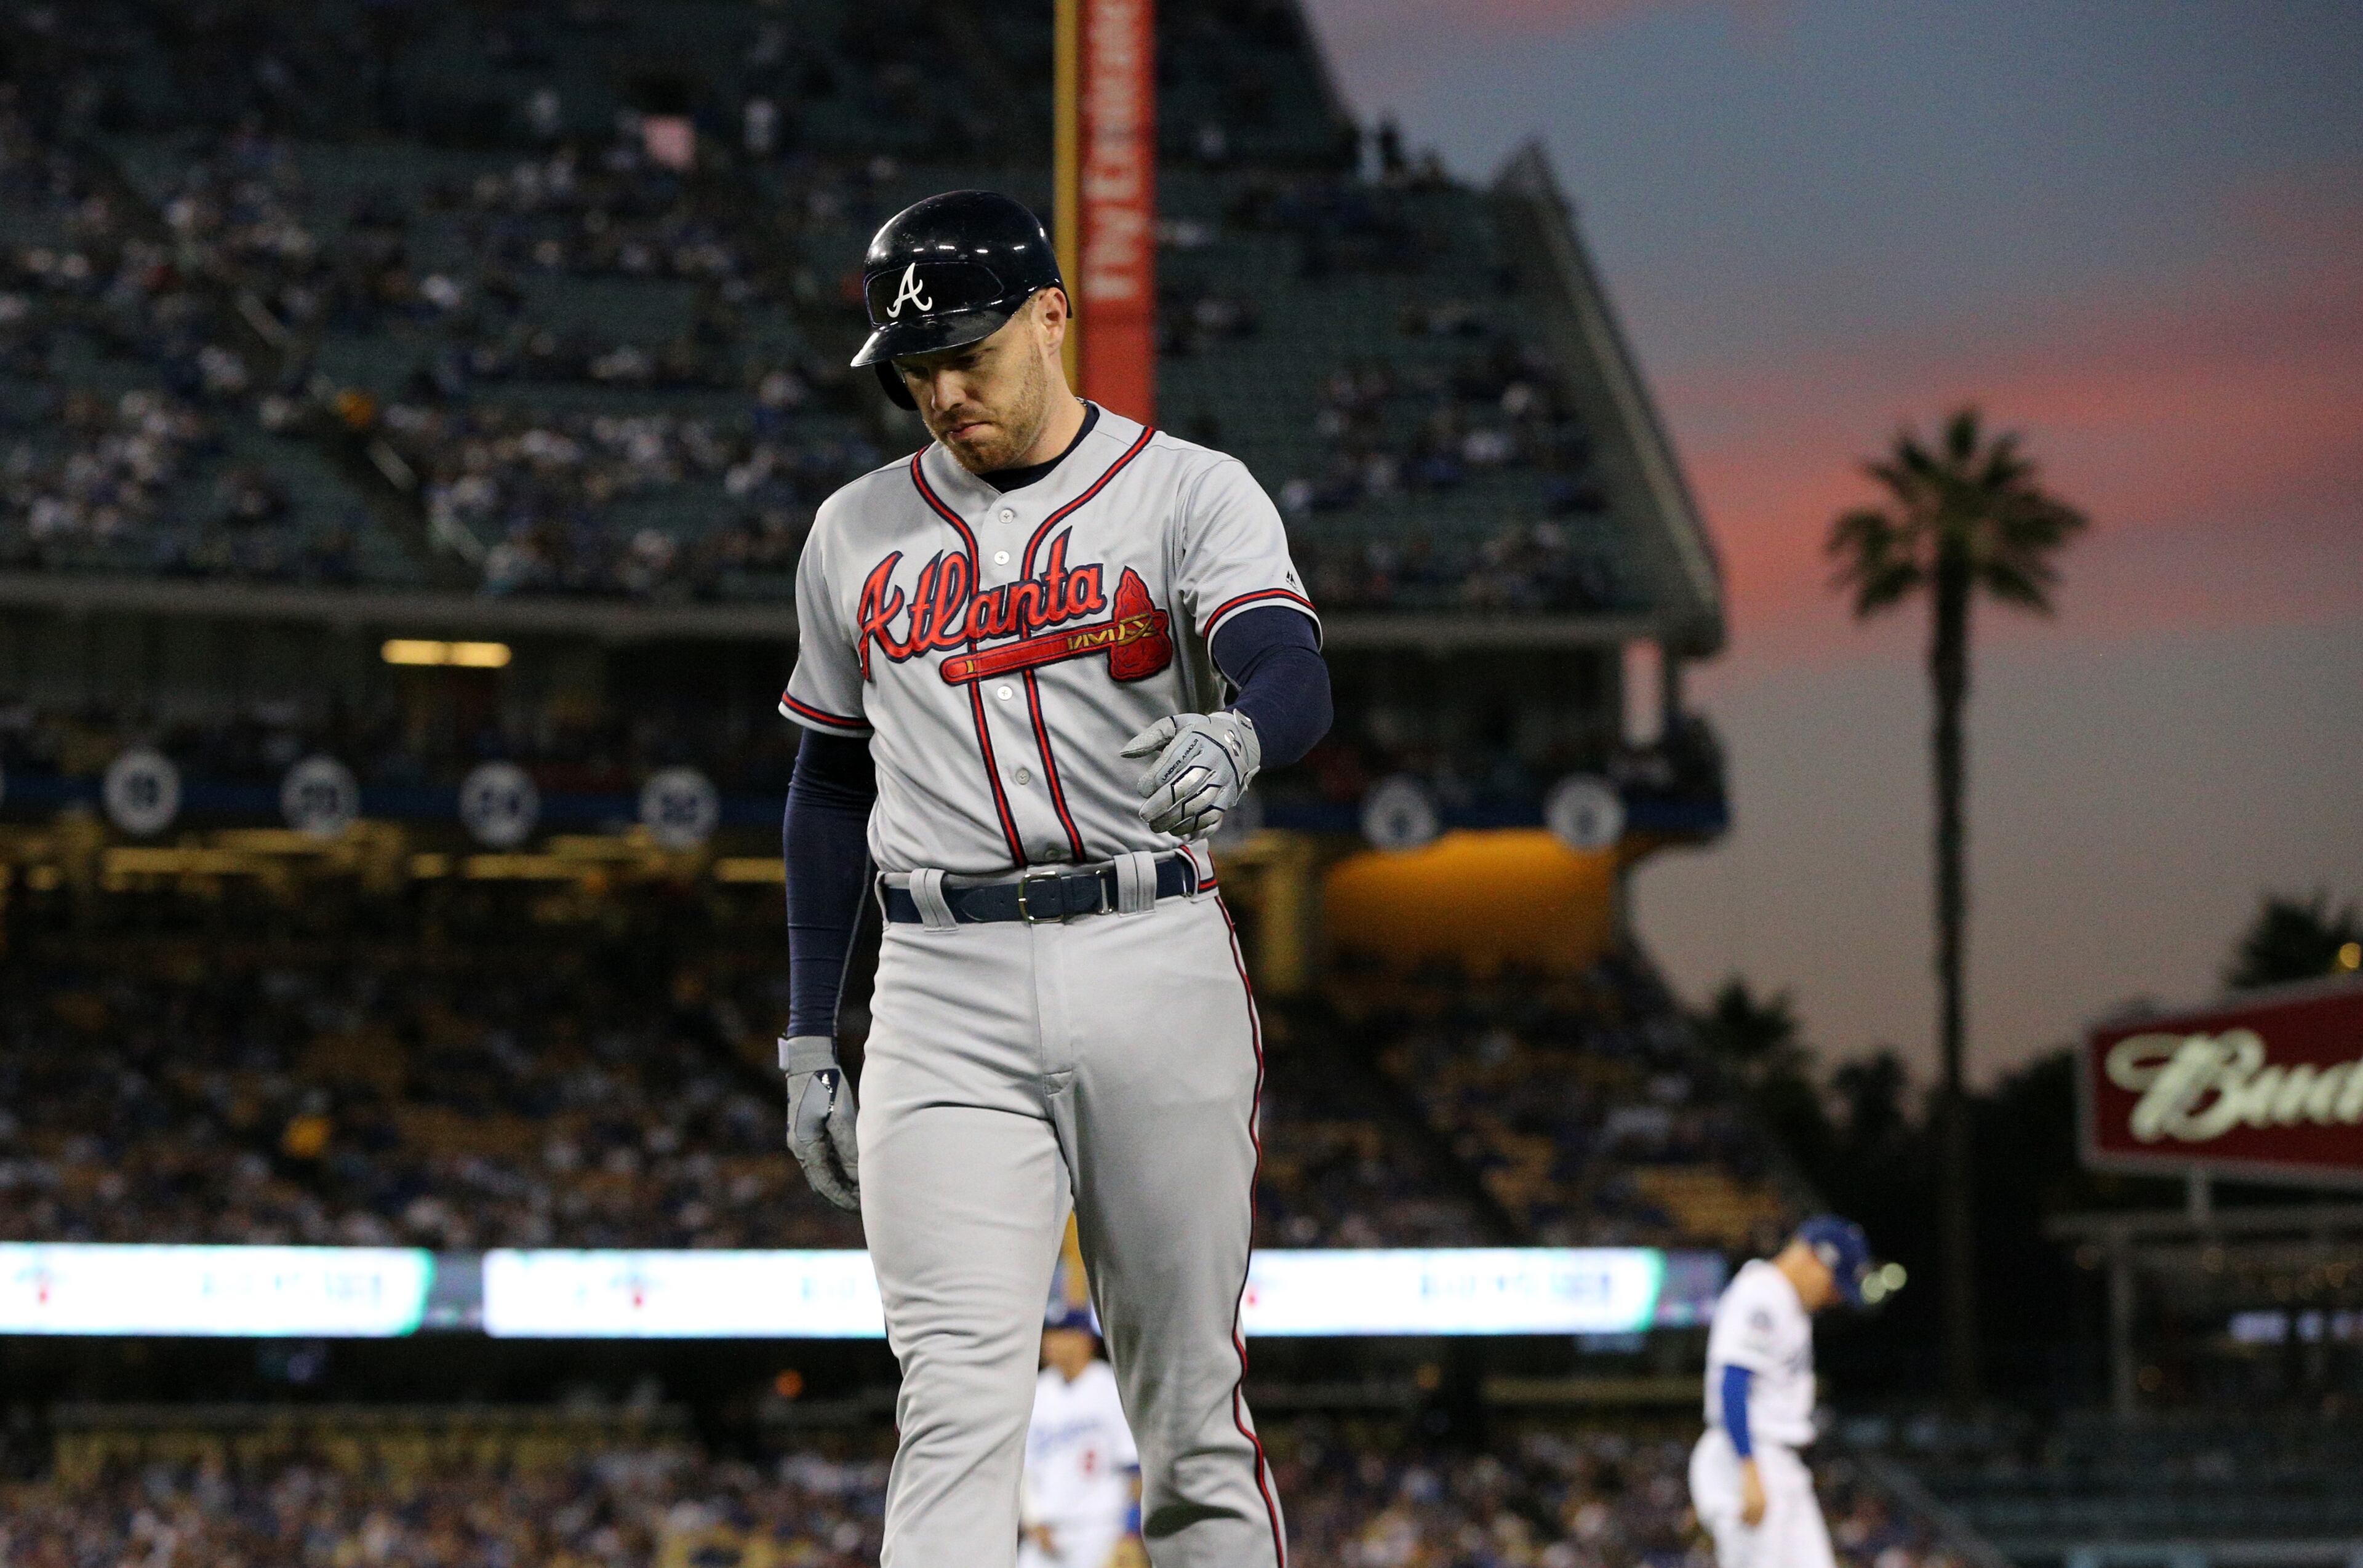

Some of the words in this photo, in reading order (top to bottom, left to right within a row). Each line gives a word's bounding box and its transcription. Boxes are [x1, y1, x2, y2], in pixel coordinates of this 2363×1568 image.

[886, 262, 933, 318] A
[857, 526, 1108, 681] Atlanta
[1162, 759, 1182, 781] UNDER
[1182, 738, 1199, 761] ARMOUR
